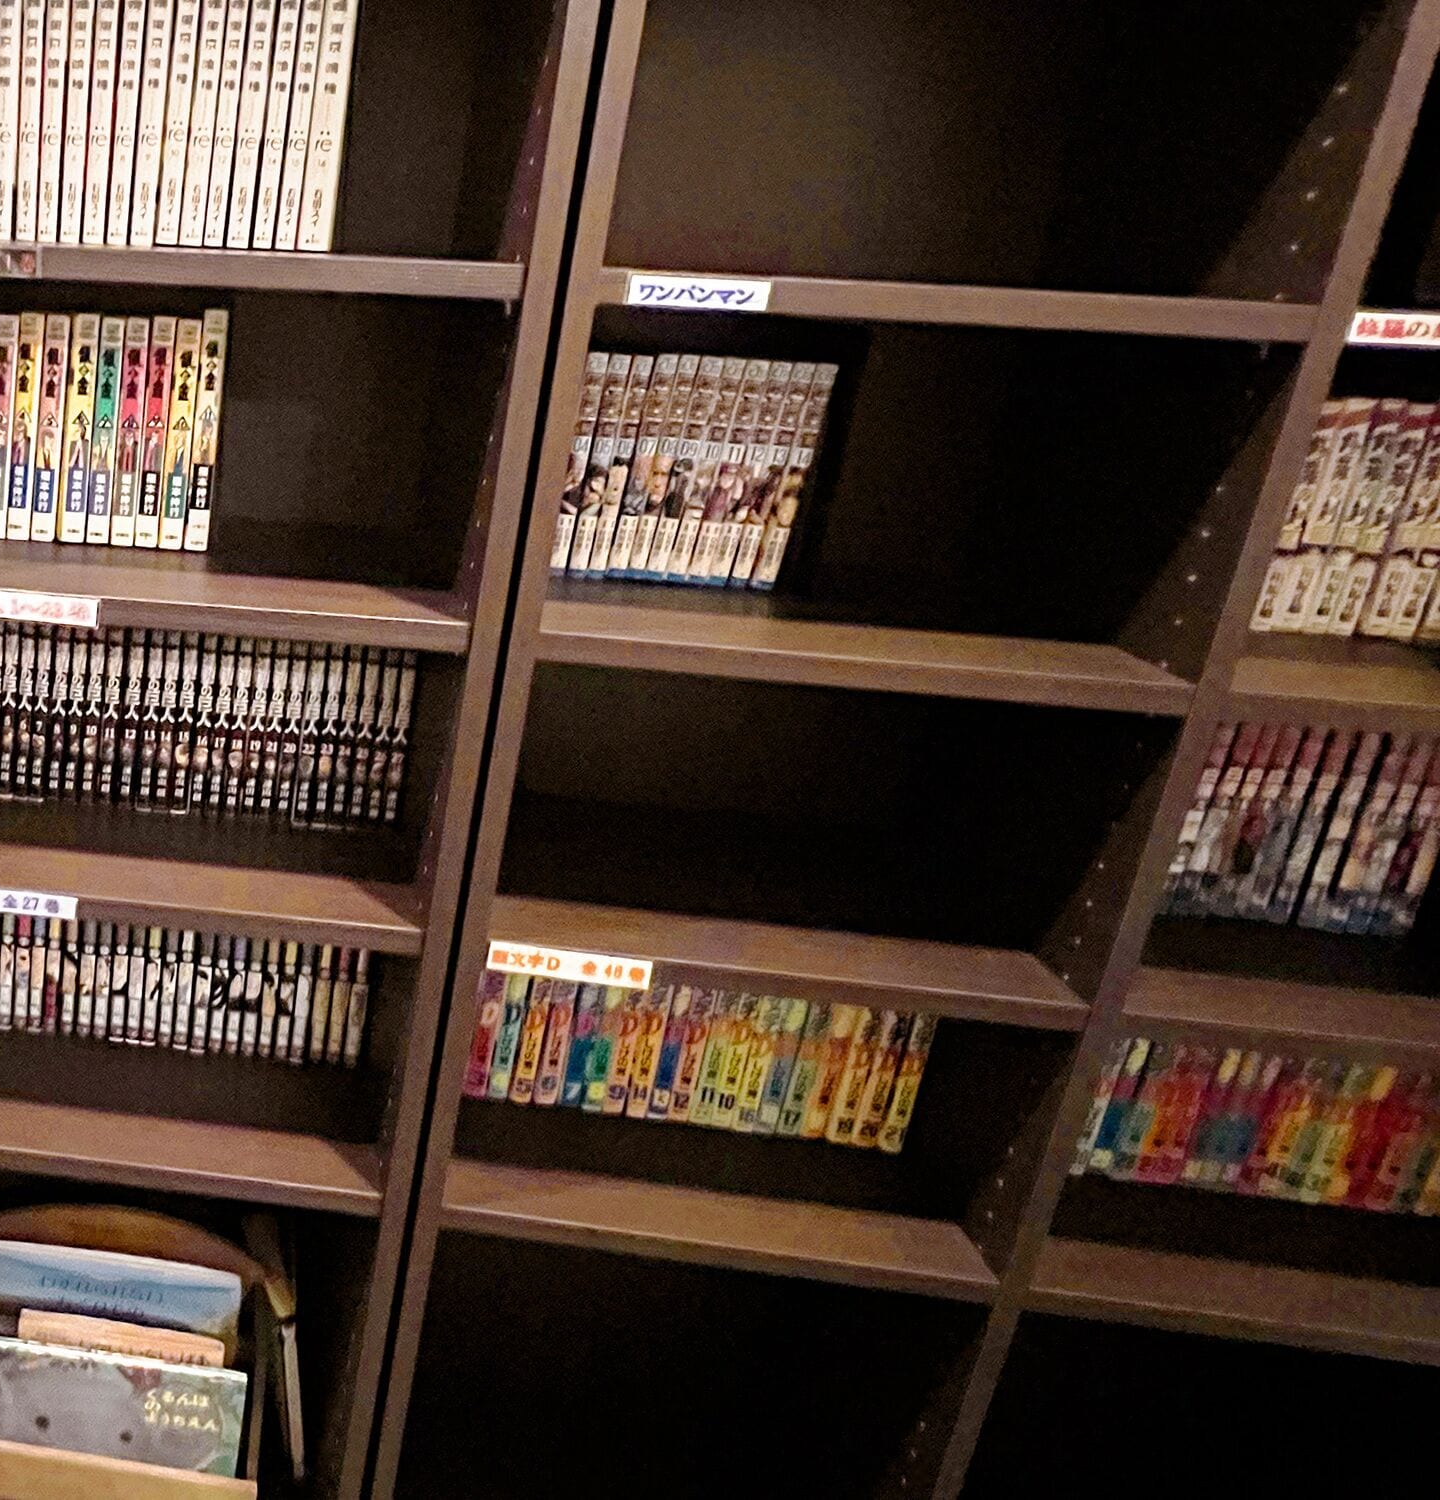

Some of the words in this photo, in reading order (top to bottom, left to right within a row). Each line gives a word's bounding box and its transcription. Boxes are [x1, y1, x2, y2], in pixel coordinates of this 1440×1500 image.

[640, 284, 755, 304] ワンパンマン
[3, 894, 18, 908] 全
[23, 896, 39, 910] 27
